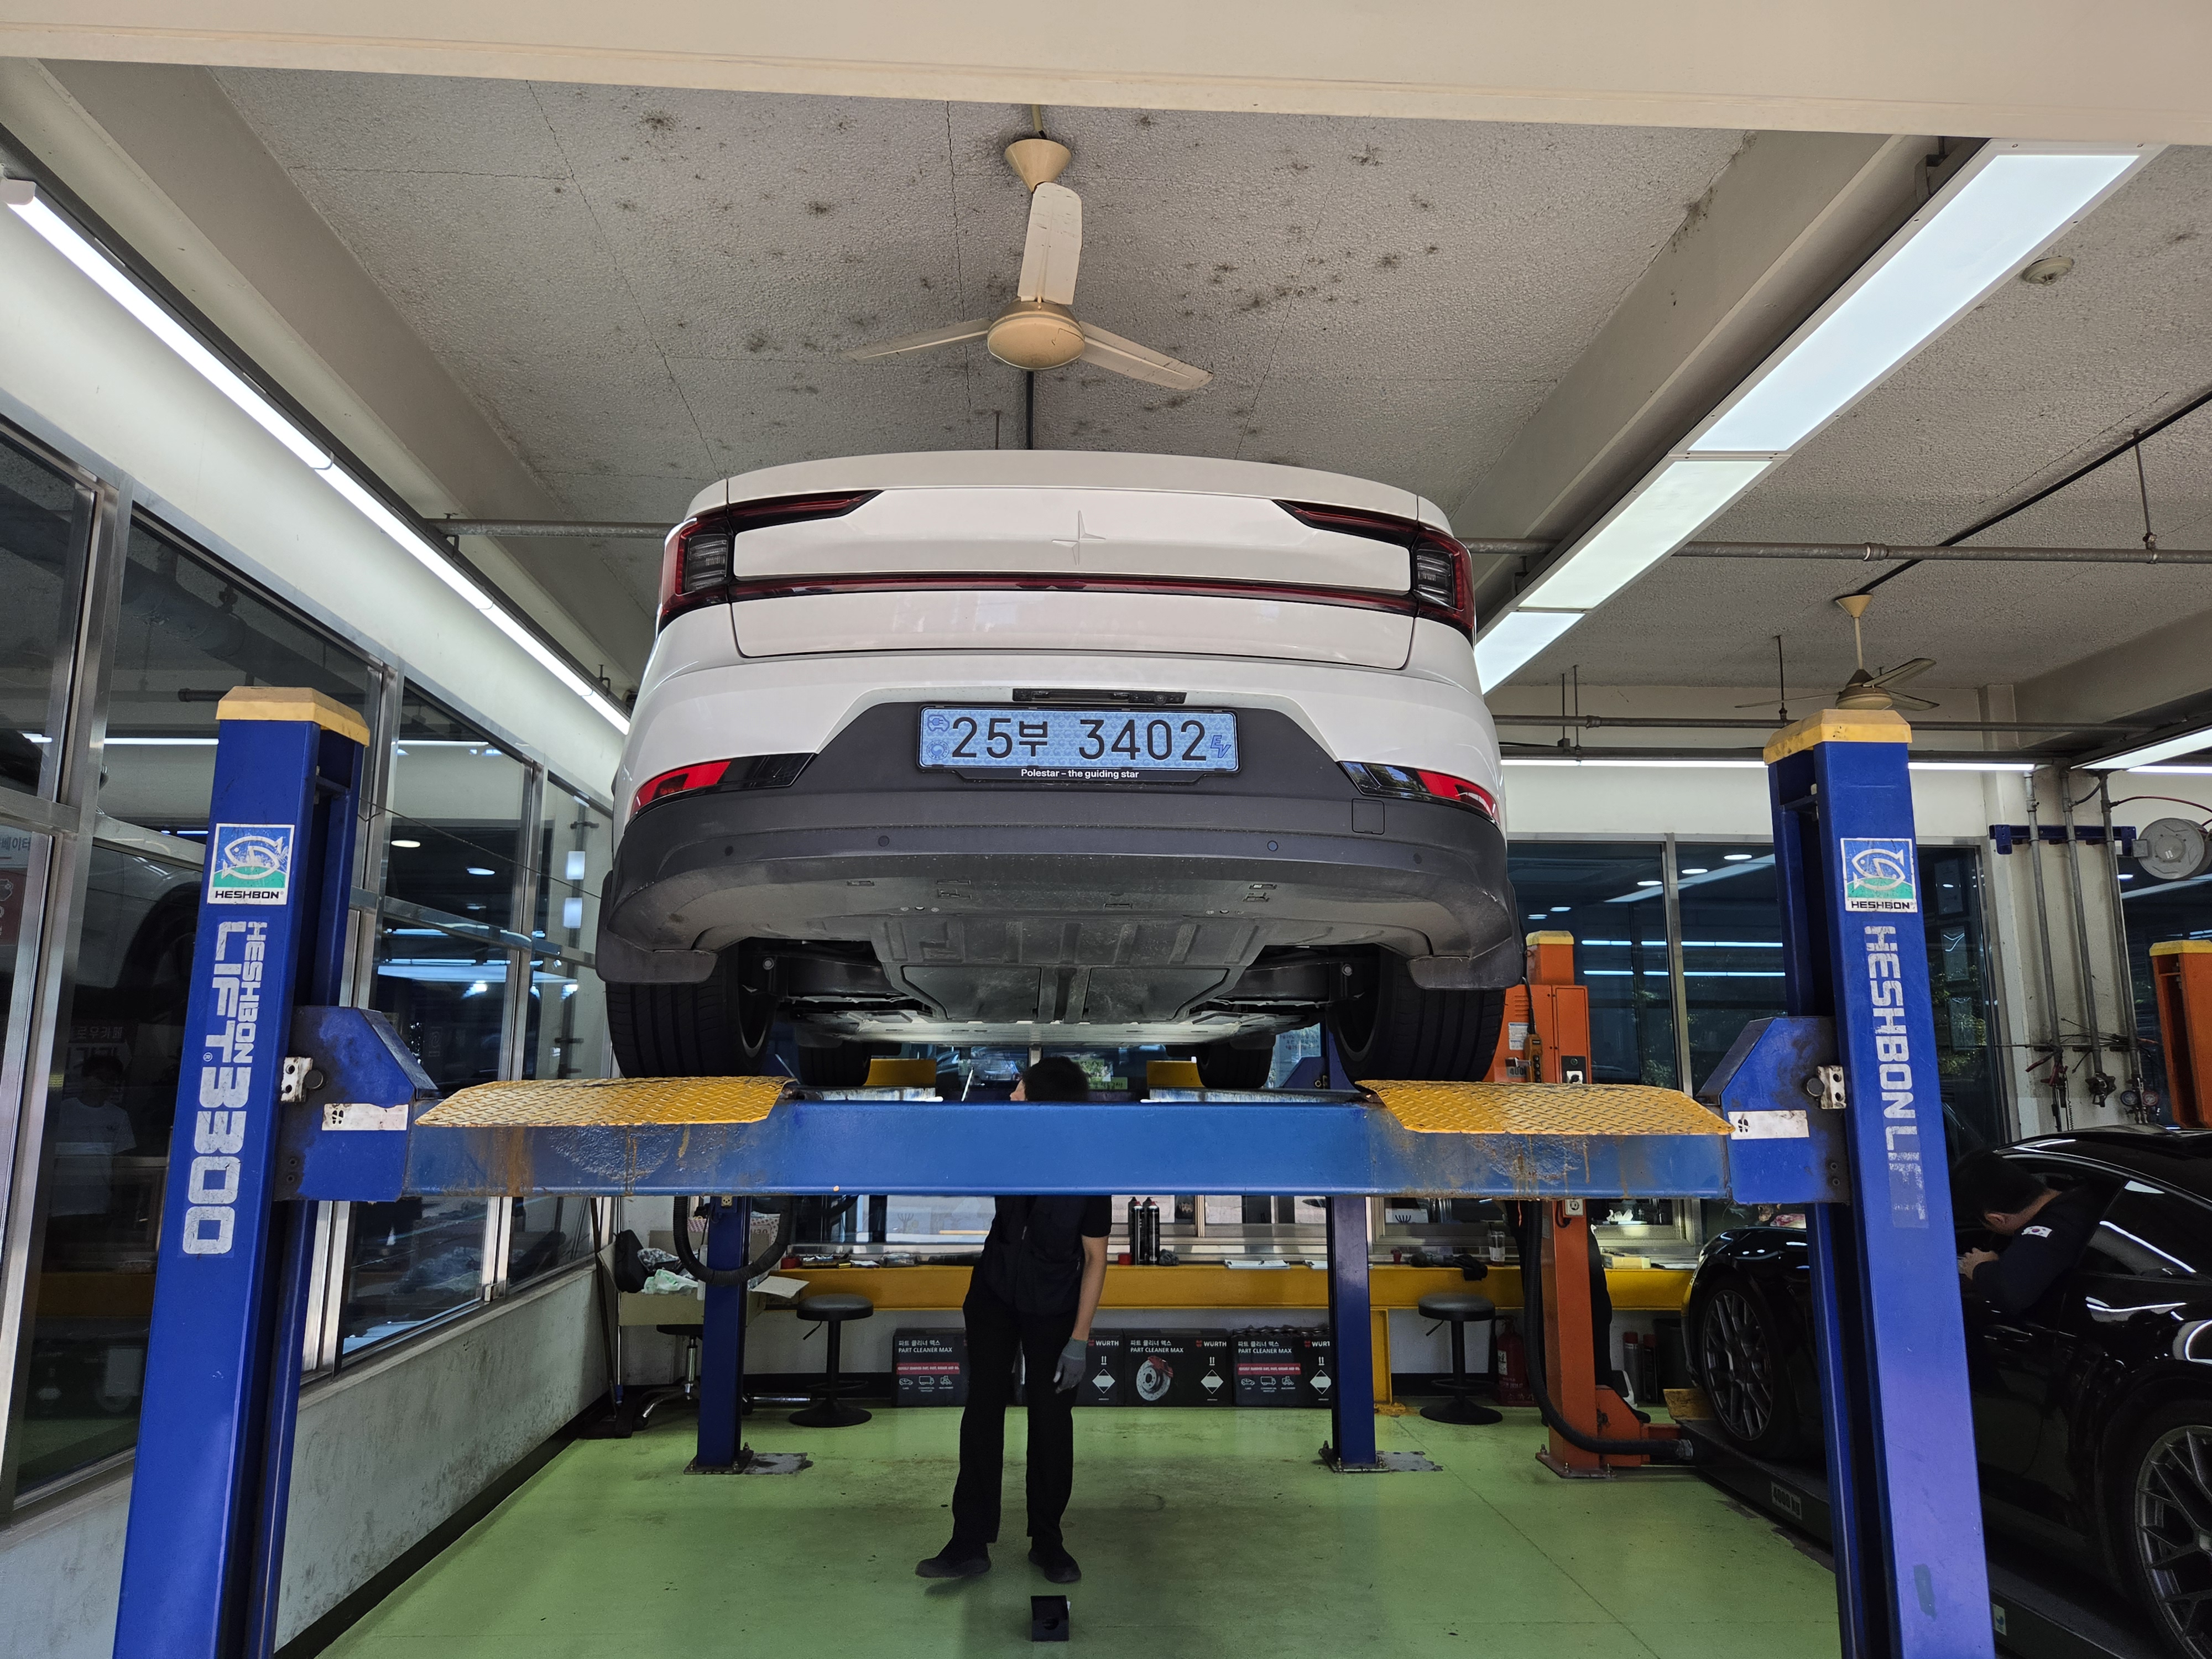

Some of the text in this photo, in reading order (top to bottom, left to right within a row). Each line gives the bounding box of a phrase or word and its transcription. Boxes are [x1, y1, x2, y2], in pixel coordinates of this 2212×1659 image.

[952, 717, 1048, 758] 25부
[1078, 719, 1207, 761] 3402
[1210, 734, 1232, 758] EV
[1021, 769, 1060, 777] Polestar
[1084, 769, 1119, 779] guiding
[0, 836, 32, 851] 베이터
[215, 890, 279, 899] HESHBON
[1851, 901, 1910, 910] HESHBON
[233, 921, 268, 1063] HESHBON
[1864, 925, 1916, 1118] HESHBON
[182, 1067, 252, 1254] 3300
